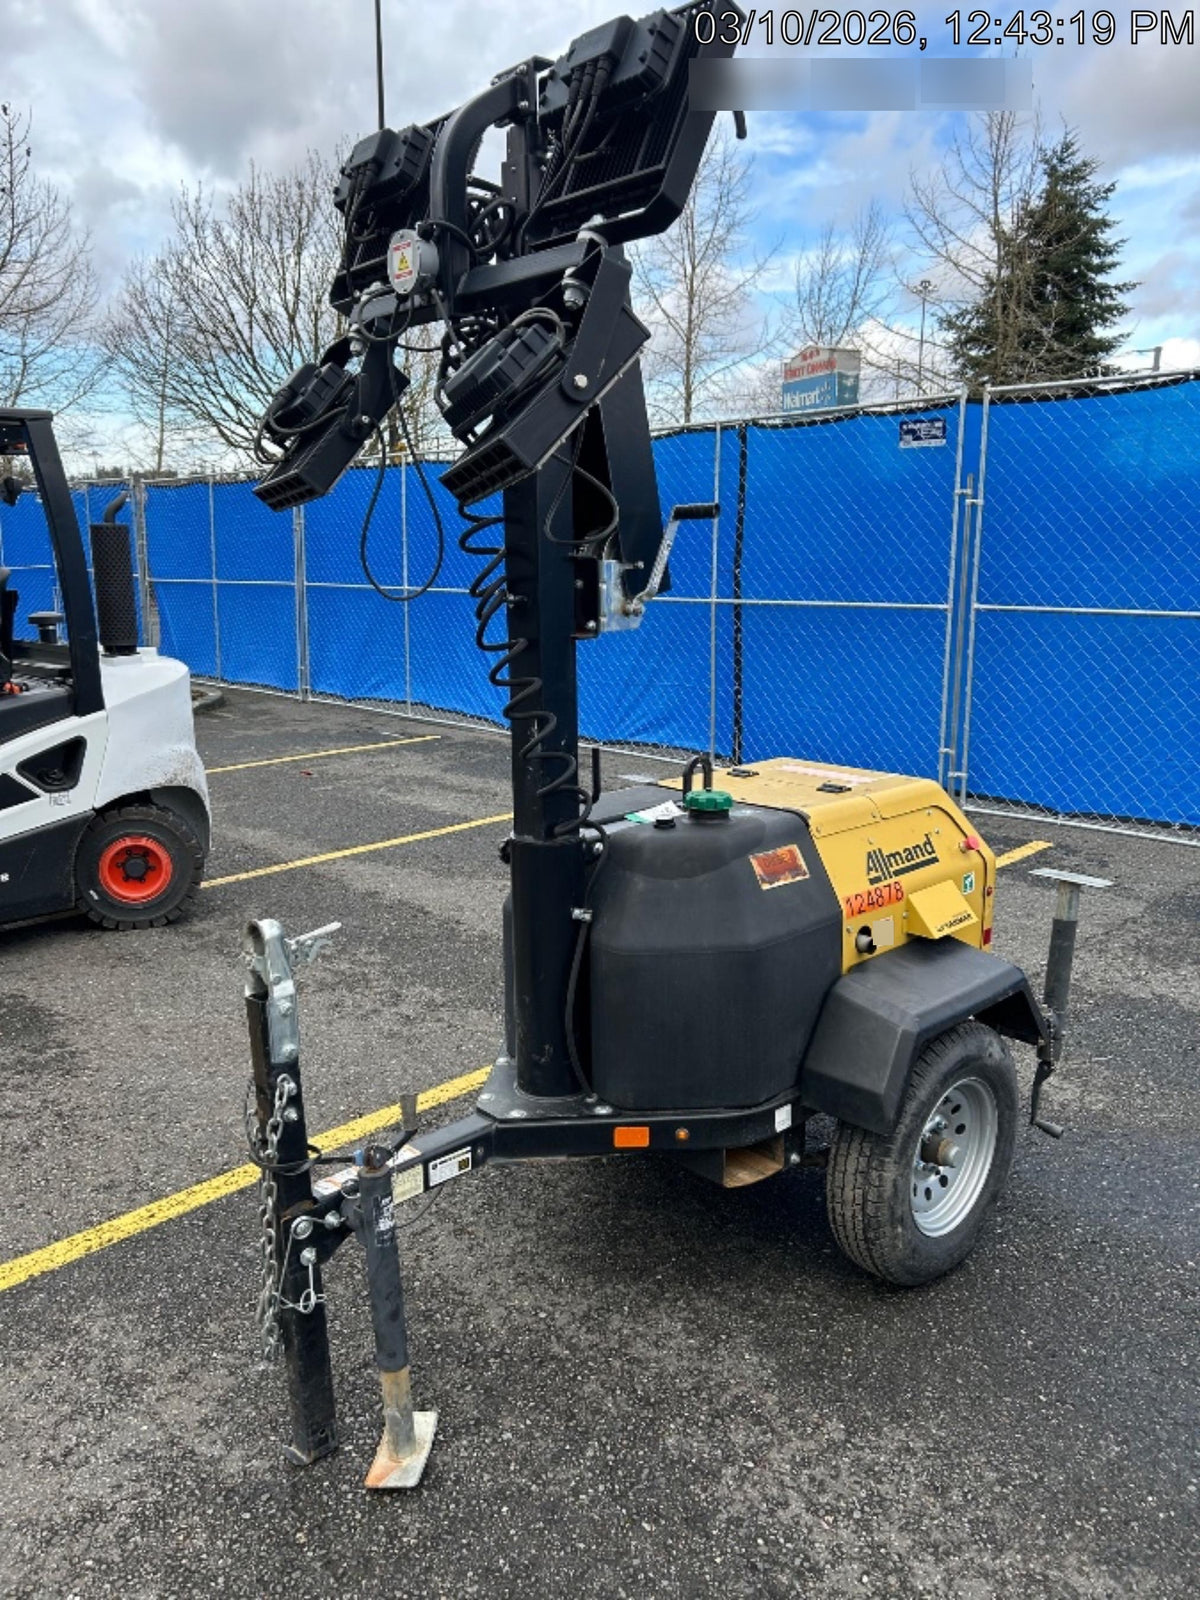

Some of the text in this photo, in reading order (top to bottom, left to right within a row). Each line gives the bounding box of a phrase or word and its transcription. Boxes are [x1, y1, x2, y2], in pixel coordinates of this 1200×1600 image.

[783, 387, 820, 409] Walmart
[866, 833, 936, 880] Allmand
[845, 881, 904, 917] 124878
